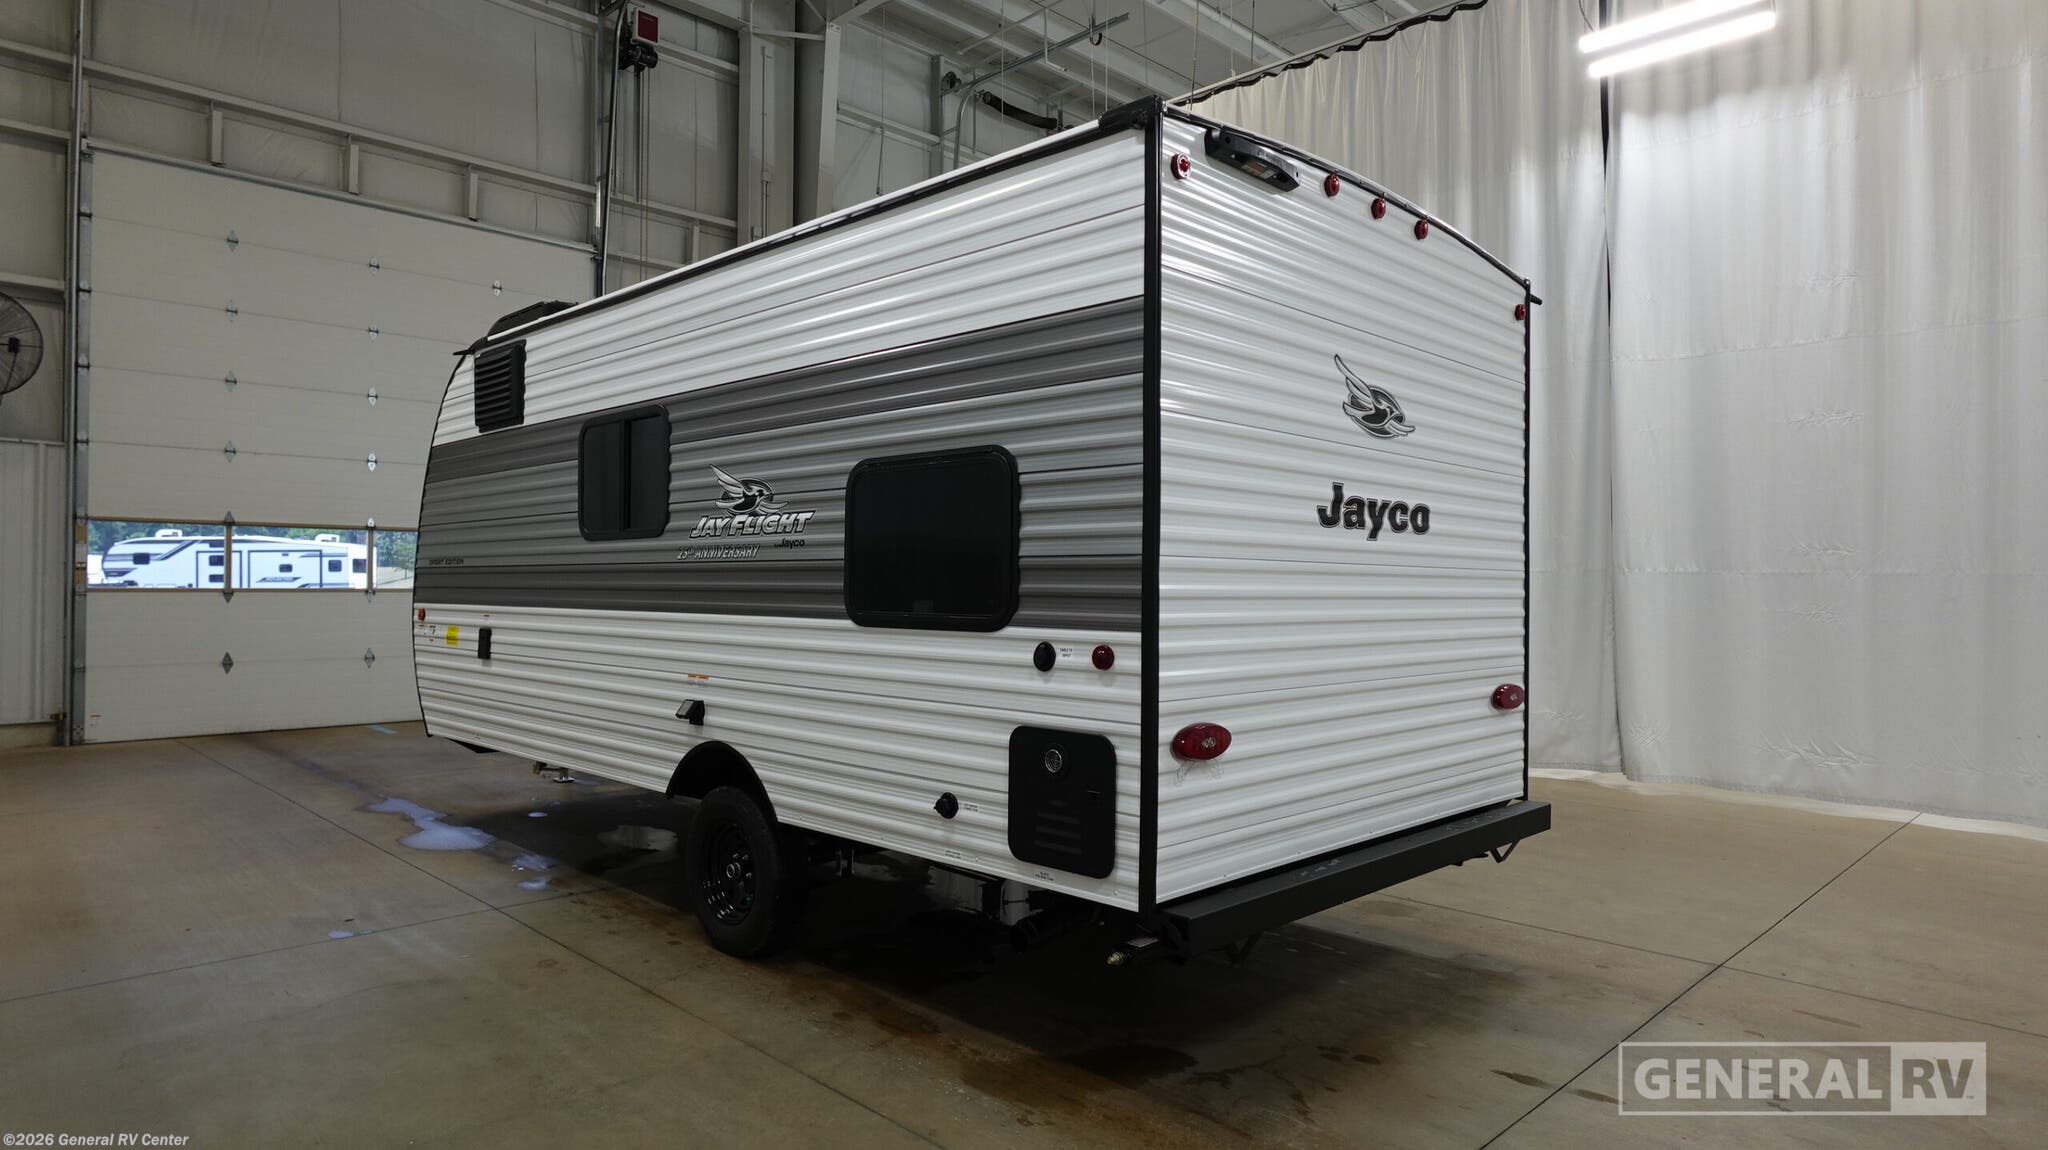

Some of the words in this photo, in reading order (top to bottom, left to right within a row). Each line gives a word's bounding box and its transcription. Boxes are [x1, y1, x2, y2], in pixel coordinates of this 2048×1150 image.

[689, 514, 732, 538] JAY
[728, 510, 816, 537] FLIGHT
[1316, 482, 1431, 541] Jayco
[694, 544, 760, 560] ANNIVERSARY
